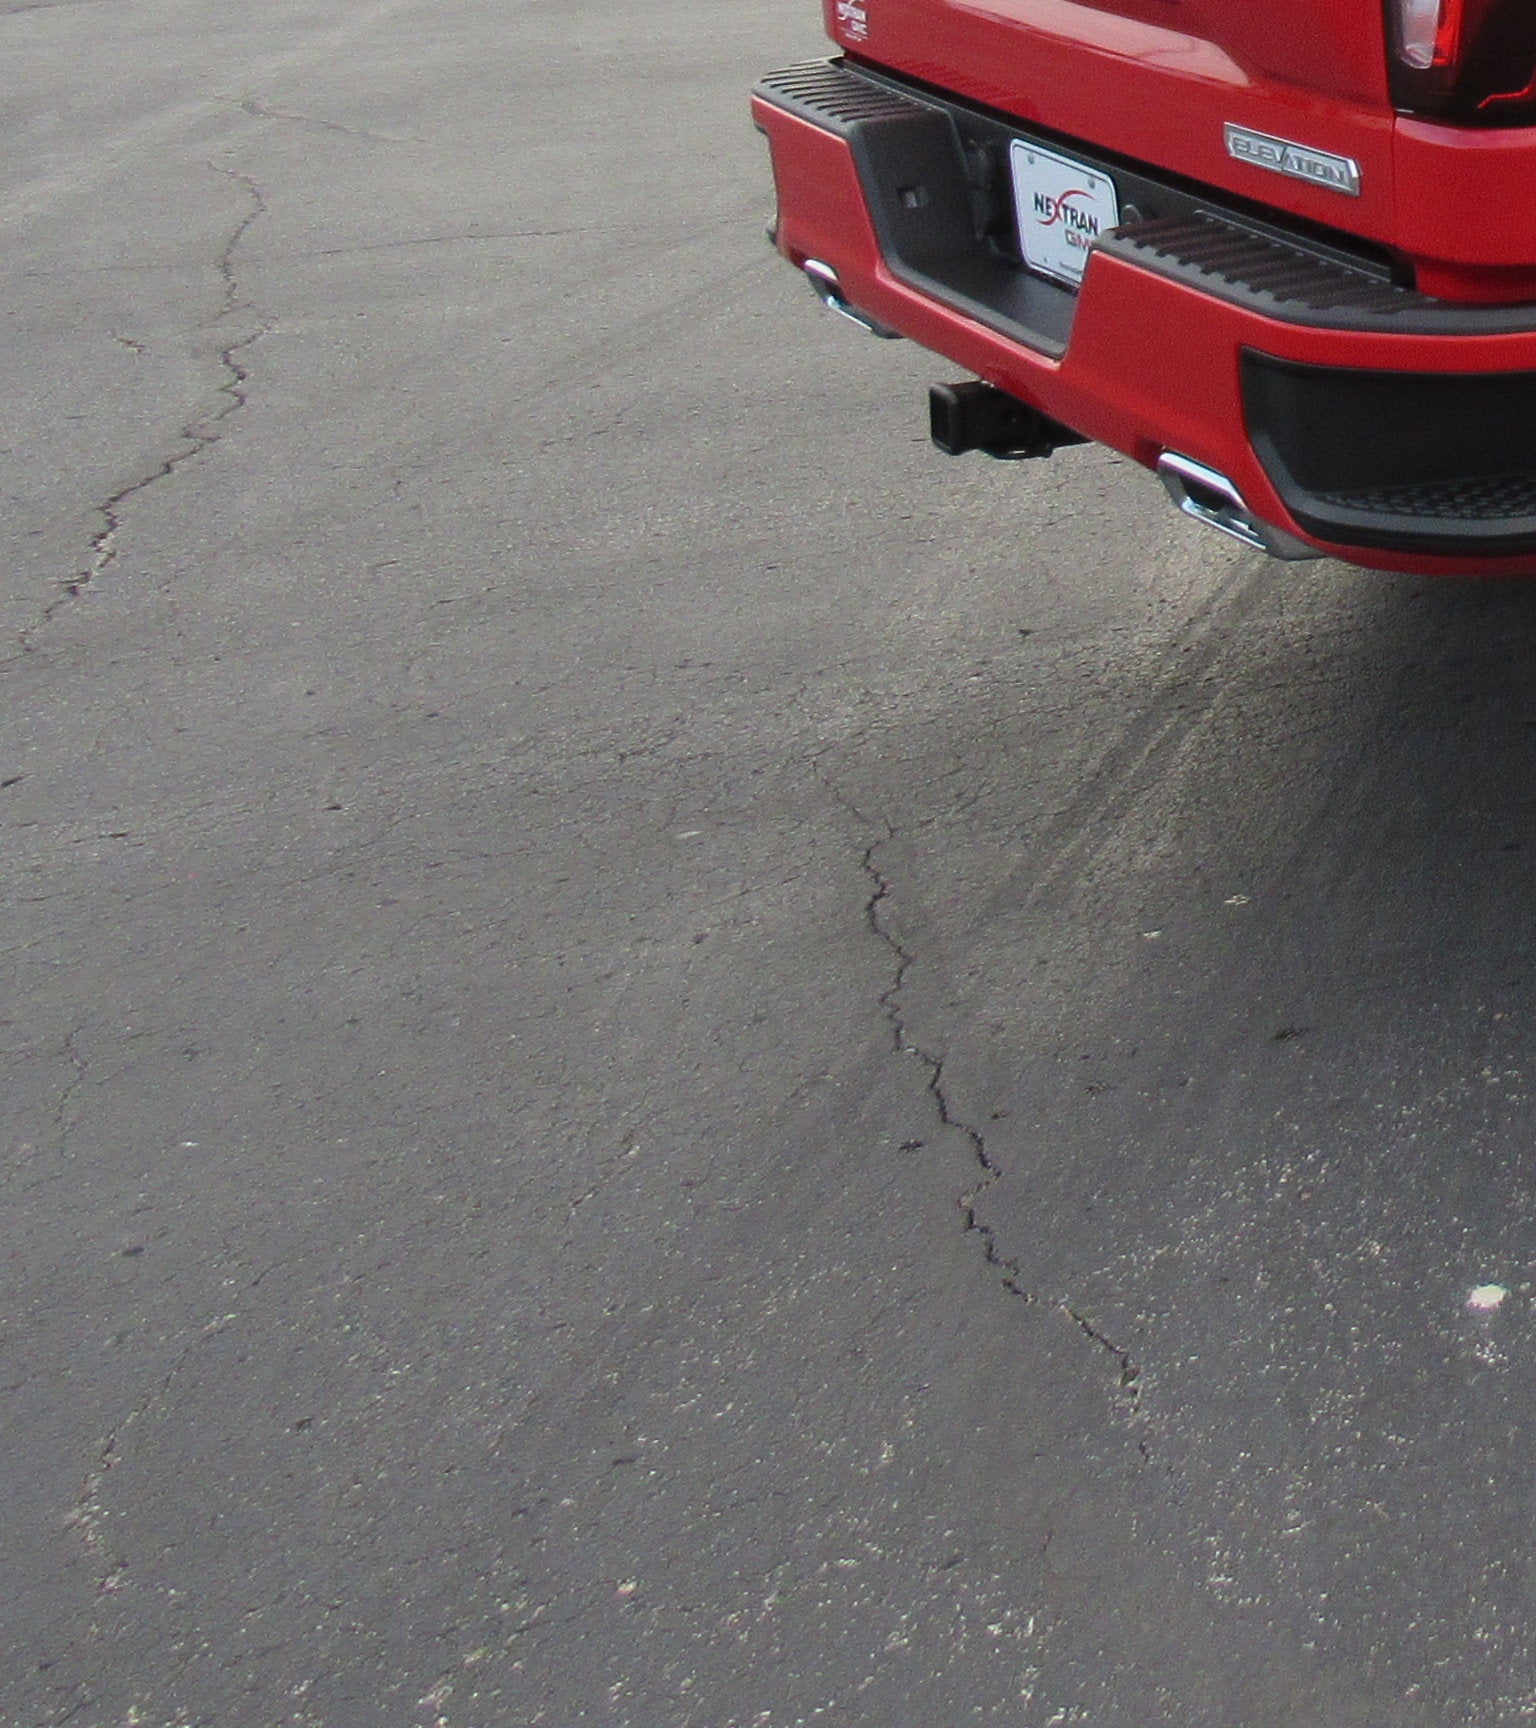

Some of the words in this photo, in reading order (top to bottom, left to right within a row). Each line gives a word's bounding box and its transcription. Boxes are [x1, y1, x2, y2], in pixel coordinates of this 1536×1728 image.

[1230, 133, 1352, 185] ELEVATION
[1034, 189, 1099, 236] NEXTRAN
[1065, 229, 1092, 251] GM
